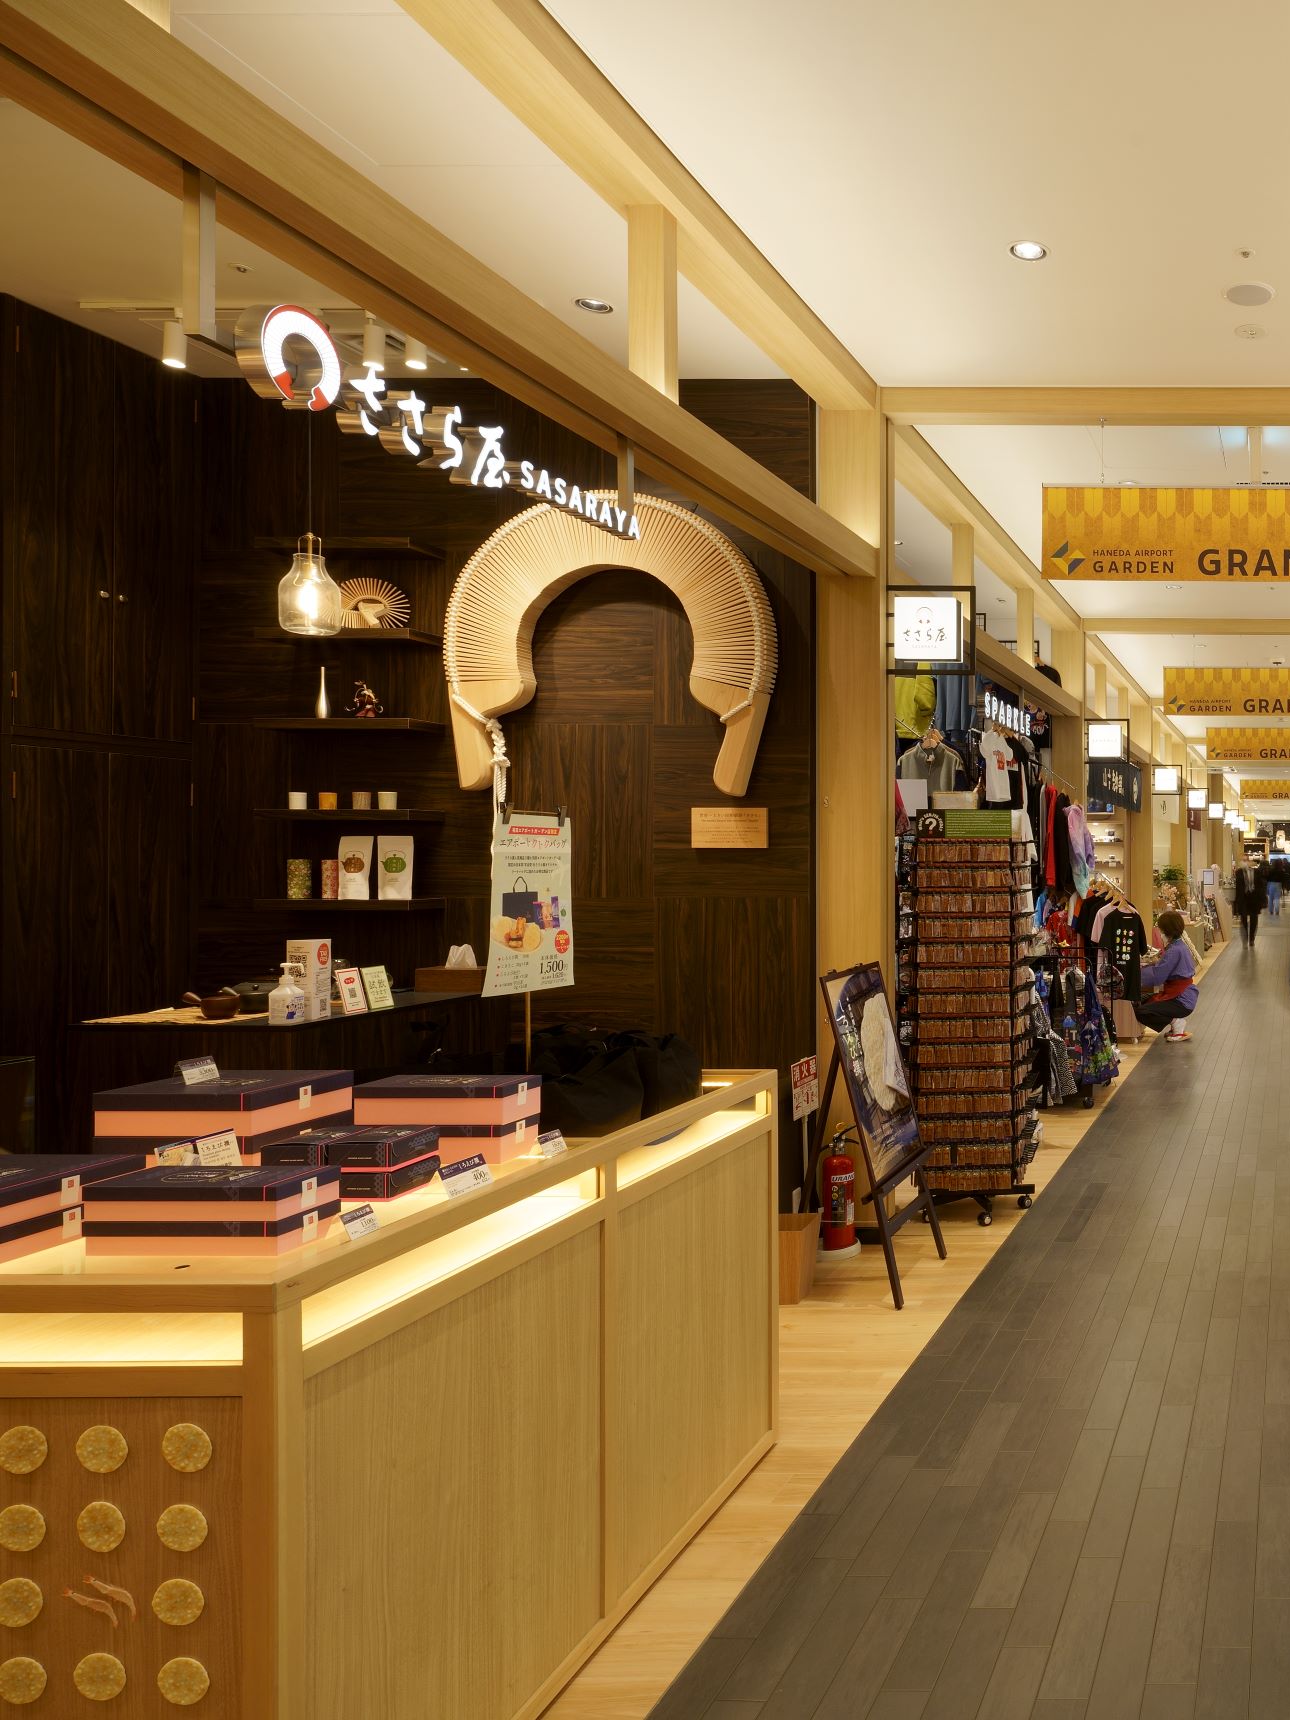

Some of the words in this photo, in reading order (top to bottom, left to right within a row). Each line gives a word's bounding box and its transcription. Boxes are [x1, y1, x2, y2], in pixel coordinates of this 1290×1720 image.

[349, 366, 510, 488] ささら屋
[520, 460, 641, 541] SASARAYA
[1092, 549, 1132, 557] HANEDA
[1134, 549, 1174, 557] AIRPORT
[1092, 560, 1175, 574] GARDEN
[903, 627, 947, 642] ささら屋
[984, 691, 1031, 737] SPARKLE
[1189, 705, 1232, 713] GARDEN
[793, 1058, 816, 1082] 消火器
